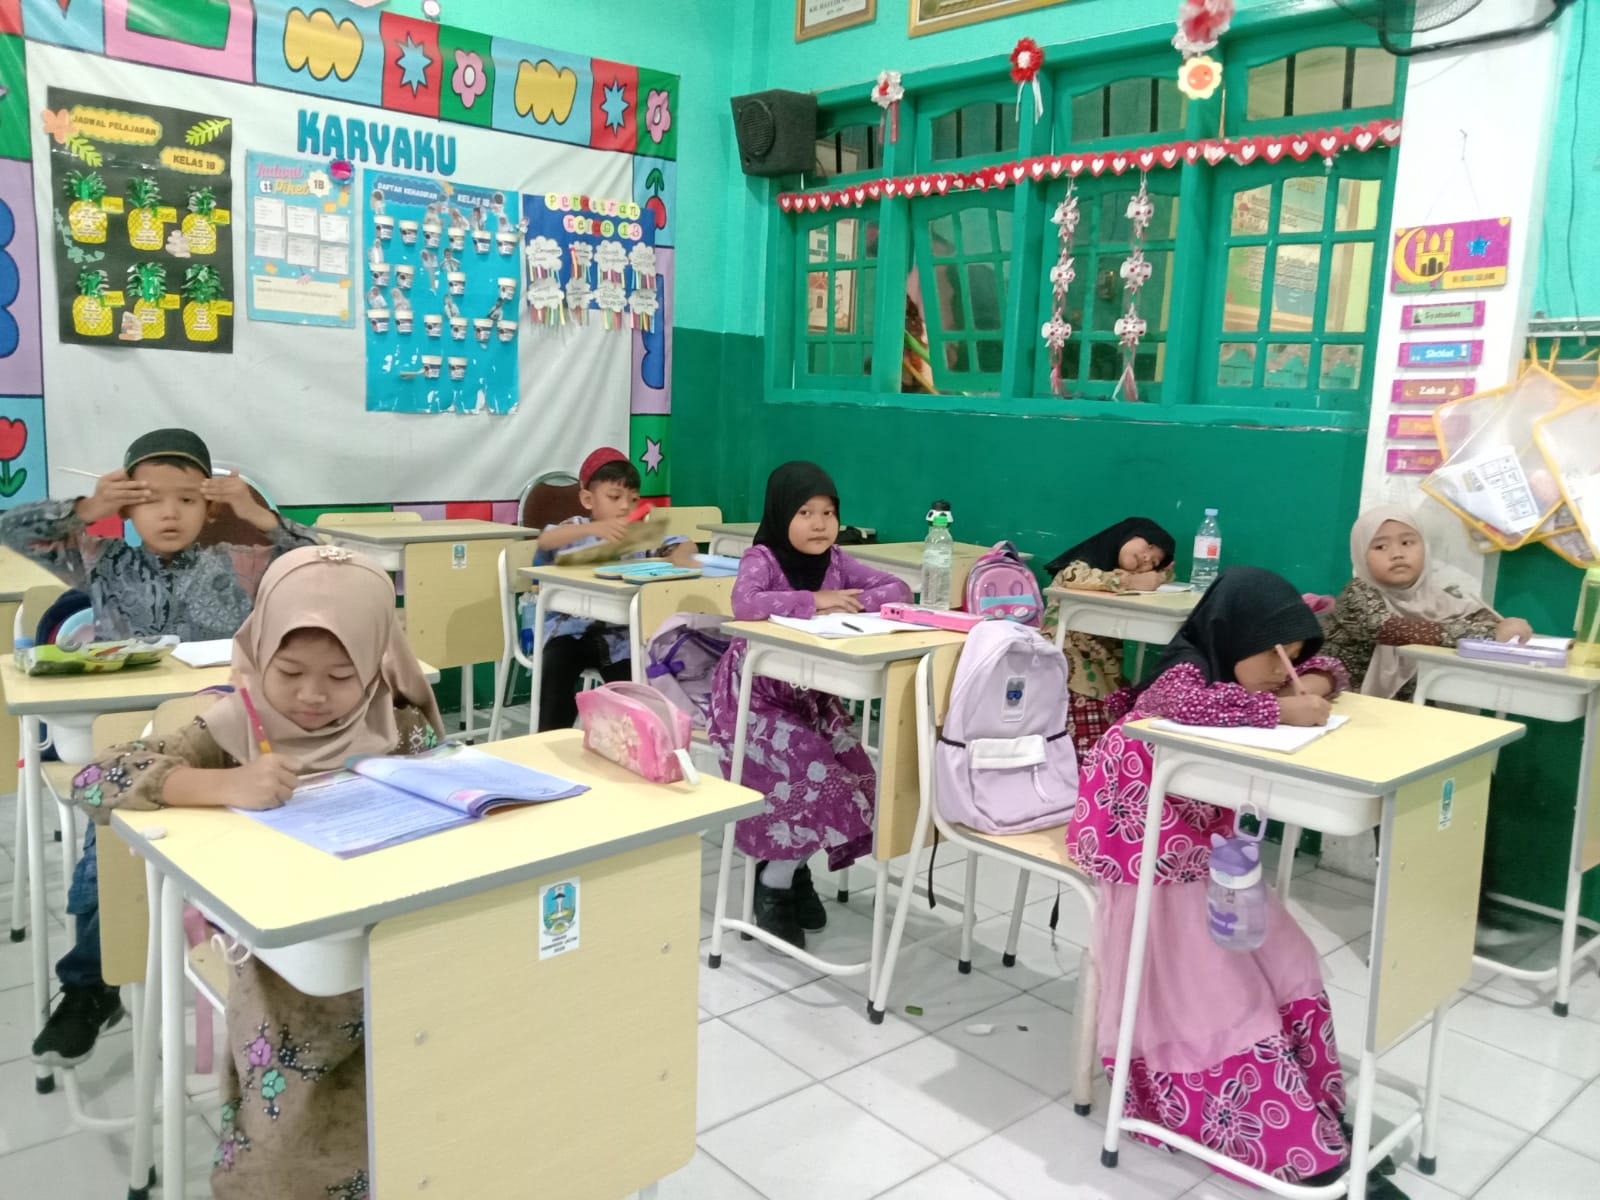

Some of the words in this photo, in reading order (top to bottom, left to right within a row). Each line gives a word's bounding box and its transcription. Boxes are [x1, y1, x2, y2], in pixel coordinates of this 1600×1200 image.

[72, 115, 106, 128] JADWAL
[108, 121, 157, 137] PELAJARAN
[297, 109, 457, 176] KARYAKU
[173, 154, 203, 168] KELAS
[205, 161, 216, 170] 1B
[313, 179, 325, 190] 1B
[377, 182, 403, 194] DAFTAR
[1418, 386, 1447, 396] Zakat
